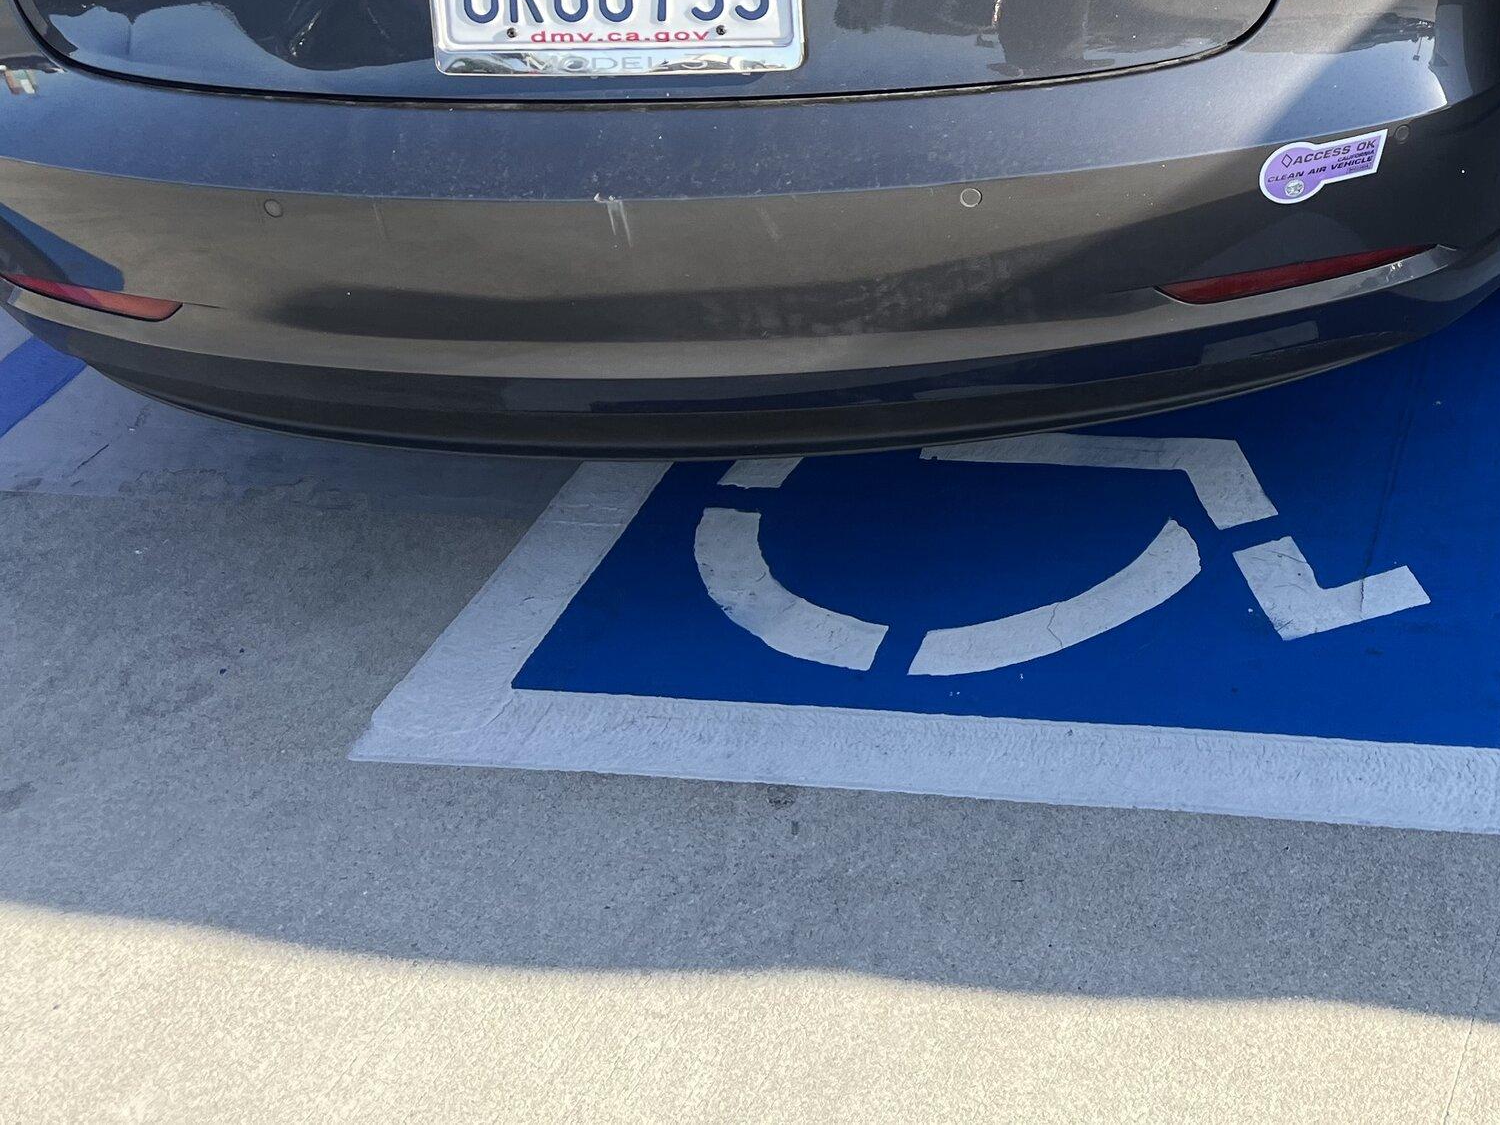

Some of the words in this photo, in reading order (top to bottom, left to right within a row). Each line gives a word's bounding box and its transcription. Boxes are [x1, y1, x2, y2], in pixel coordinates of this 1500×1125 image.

[530, 29, 710, 43] dmv.ca.gov
[525, 53, 669, 72] MODEL
[1292, 145, 1351, 165] ACCESS
[1356, 139, 1376, 153] OK
[1337, 149, 1375, 162] CALIFORNIA
[1267, 171, 1305, 183] CLEAN
[1307, 166, 1327, 176] AIR
[1331, 155, 1374, 170] VEHICLE
